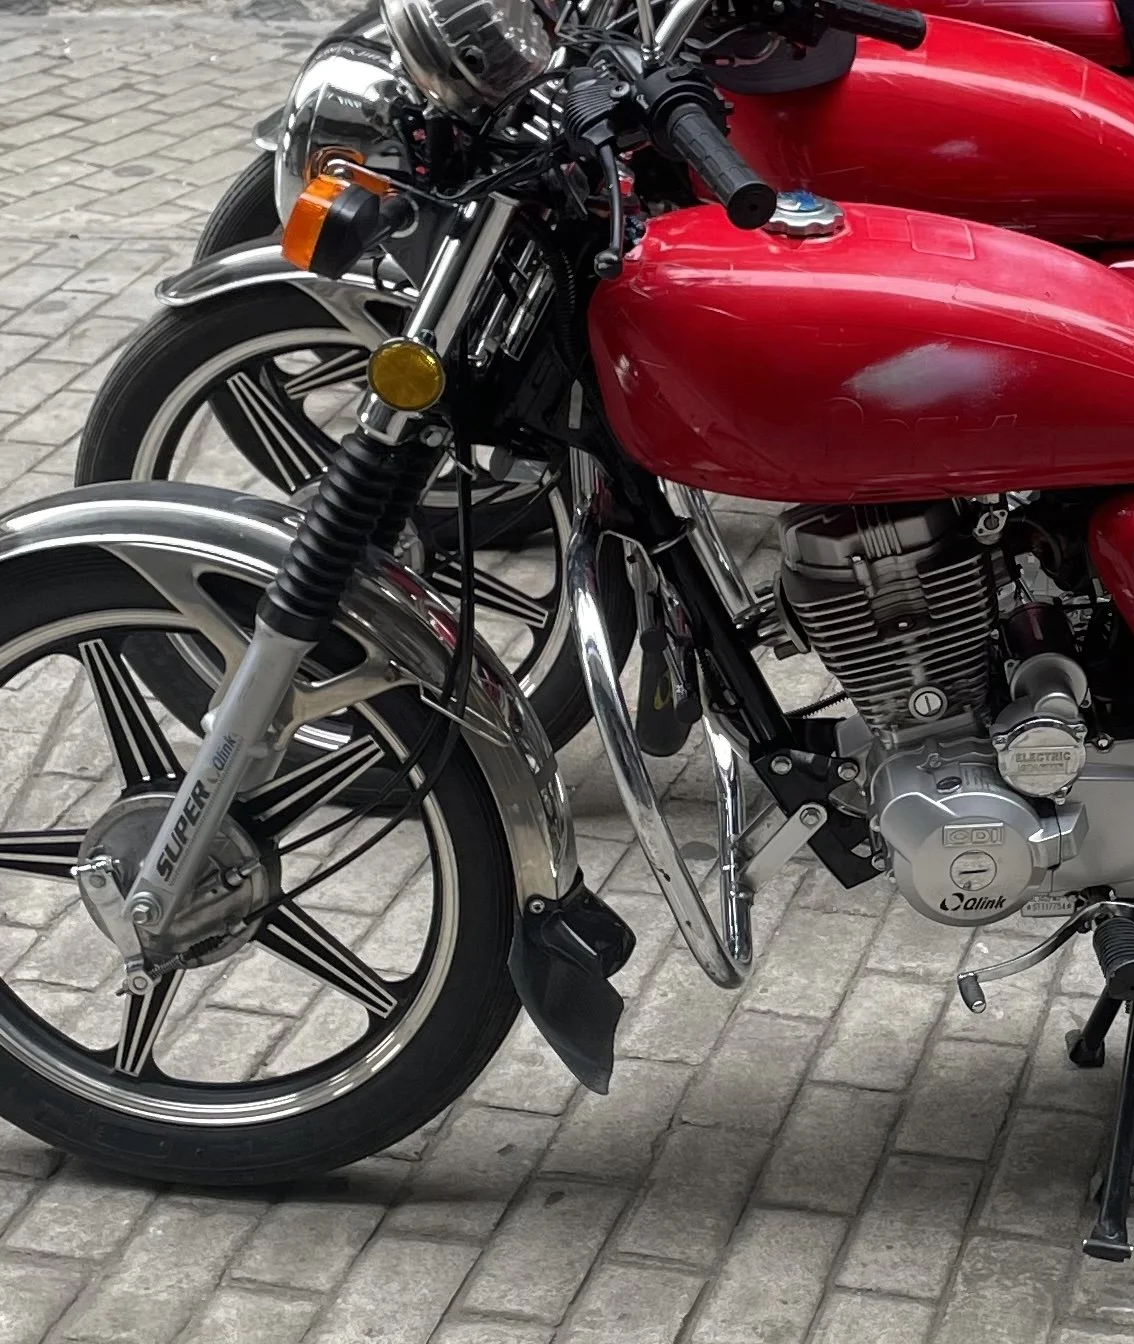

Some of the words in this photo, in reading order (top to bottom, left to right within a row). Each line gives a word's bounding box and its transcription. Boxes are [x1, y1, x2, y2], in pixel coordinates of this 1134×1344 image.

[1015, 751, 1072, 763] ELECTRIC
[156, 779, 211, 882] SUPER
[948, 828, 999, 845] CDI
